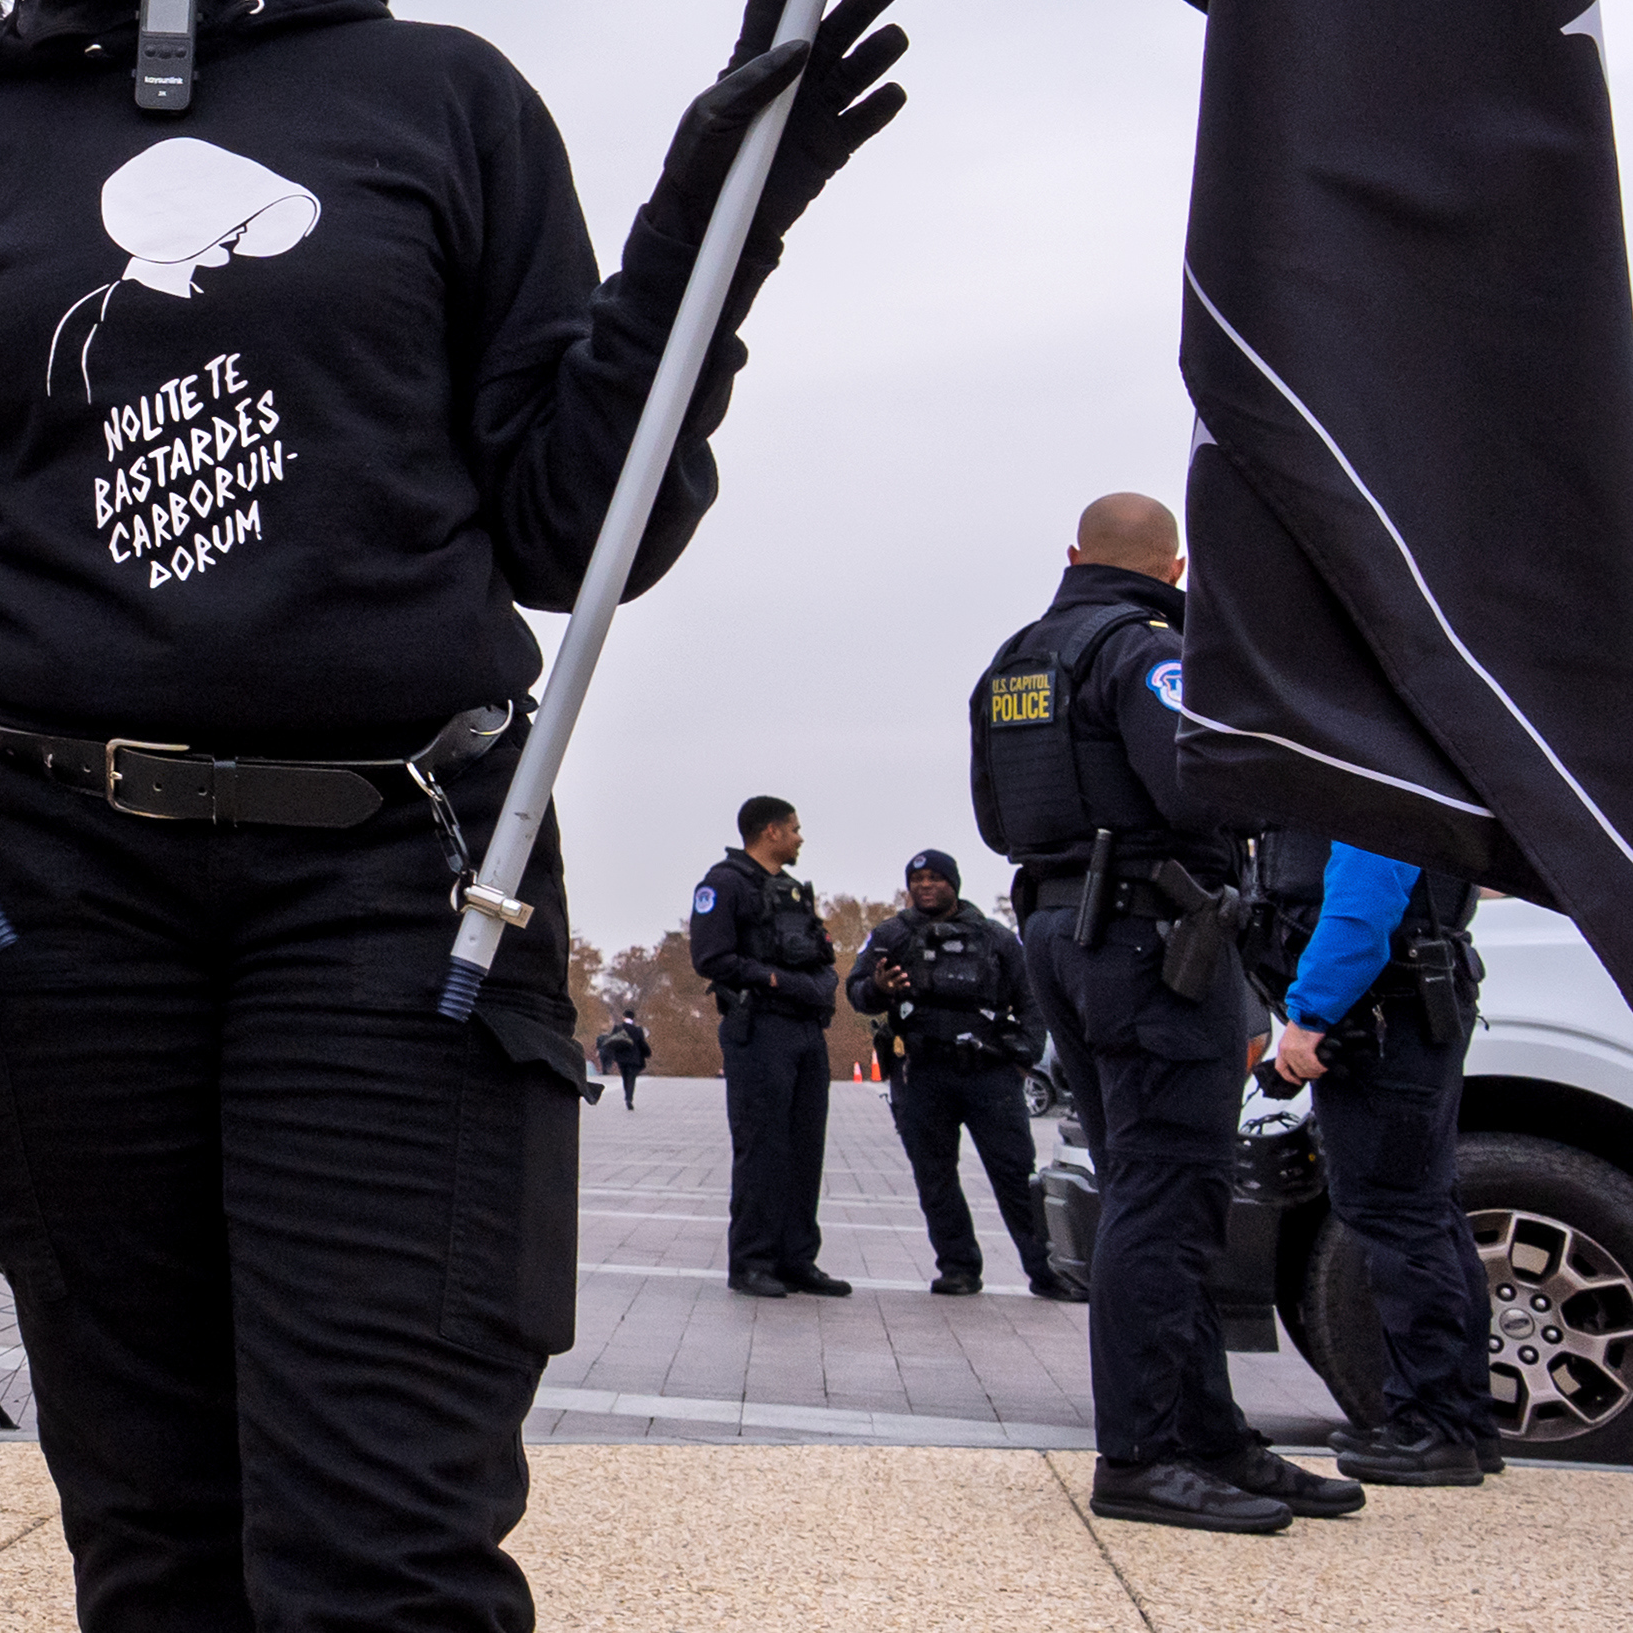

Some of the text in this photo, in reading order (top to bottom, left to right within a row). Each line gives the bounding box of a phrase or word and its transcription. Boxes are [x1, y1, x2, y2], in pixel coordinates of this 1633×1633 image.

[104, 353, 248, 462] NOLITE TE
[94, 390, 280, 529] BASTARDES
[108, 440, 298, 563] CARBORUN-
[149, 499, 263, 589] DORUM
[992, 690, 1051, 722] POLICE
[1009, 674, 1051, 692] CAPITOL
